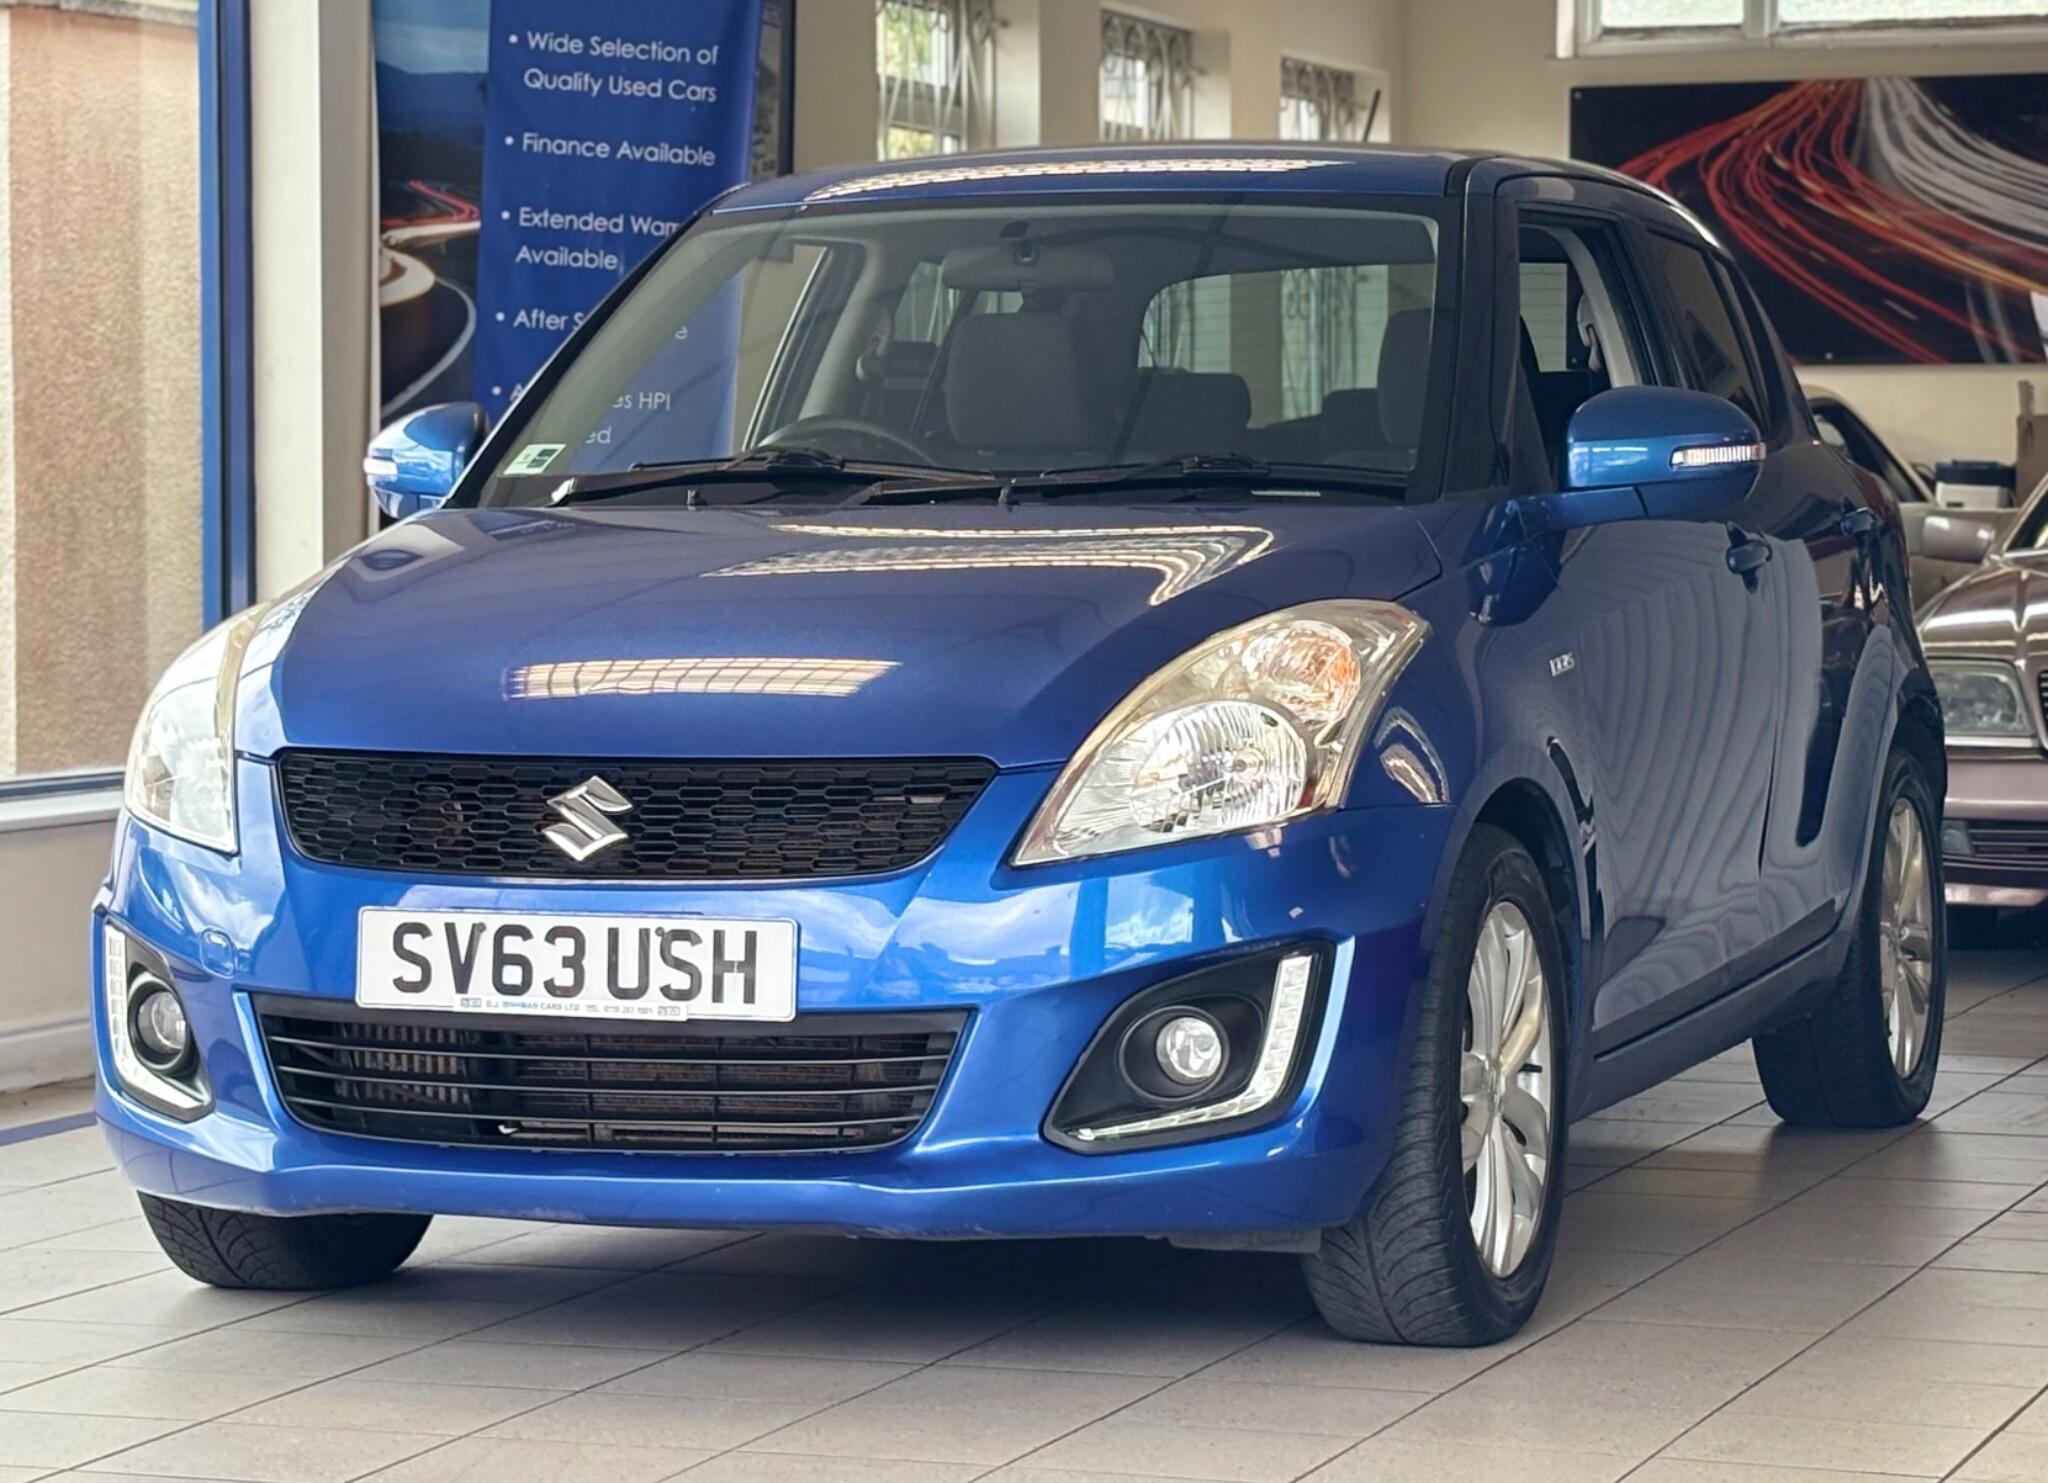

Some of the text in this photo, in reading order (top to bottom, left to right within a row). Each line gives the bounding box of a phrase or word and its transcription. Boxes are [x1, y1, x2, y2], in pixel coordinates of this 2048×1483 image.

[527, 31, 719, 65] Wide Selection of
[524, 68, 717, 102] Quality Used Cars
[522, 132, 716, 166] Finance Available
[519, 207, 624, 233] Extended
[515, 245, 618, 270] Available
[513, 309, 569, 331] After
[638, 392, 671, 410] HPI
[392, 922, 758, 1004] SV63 USH
